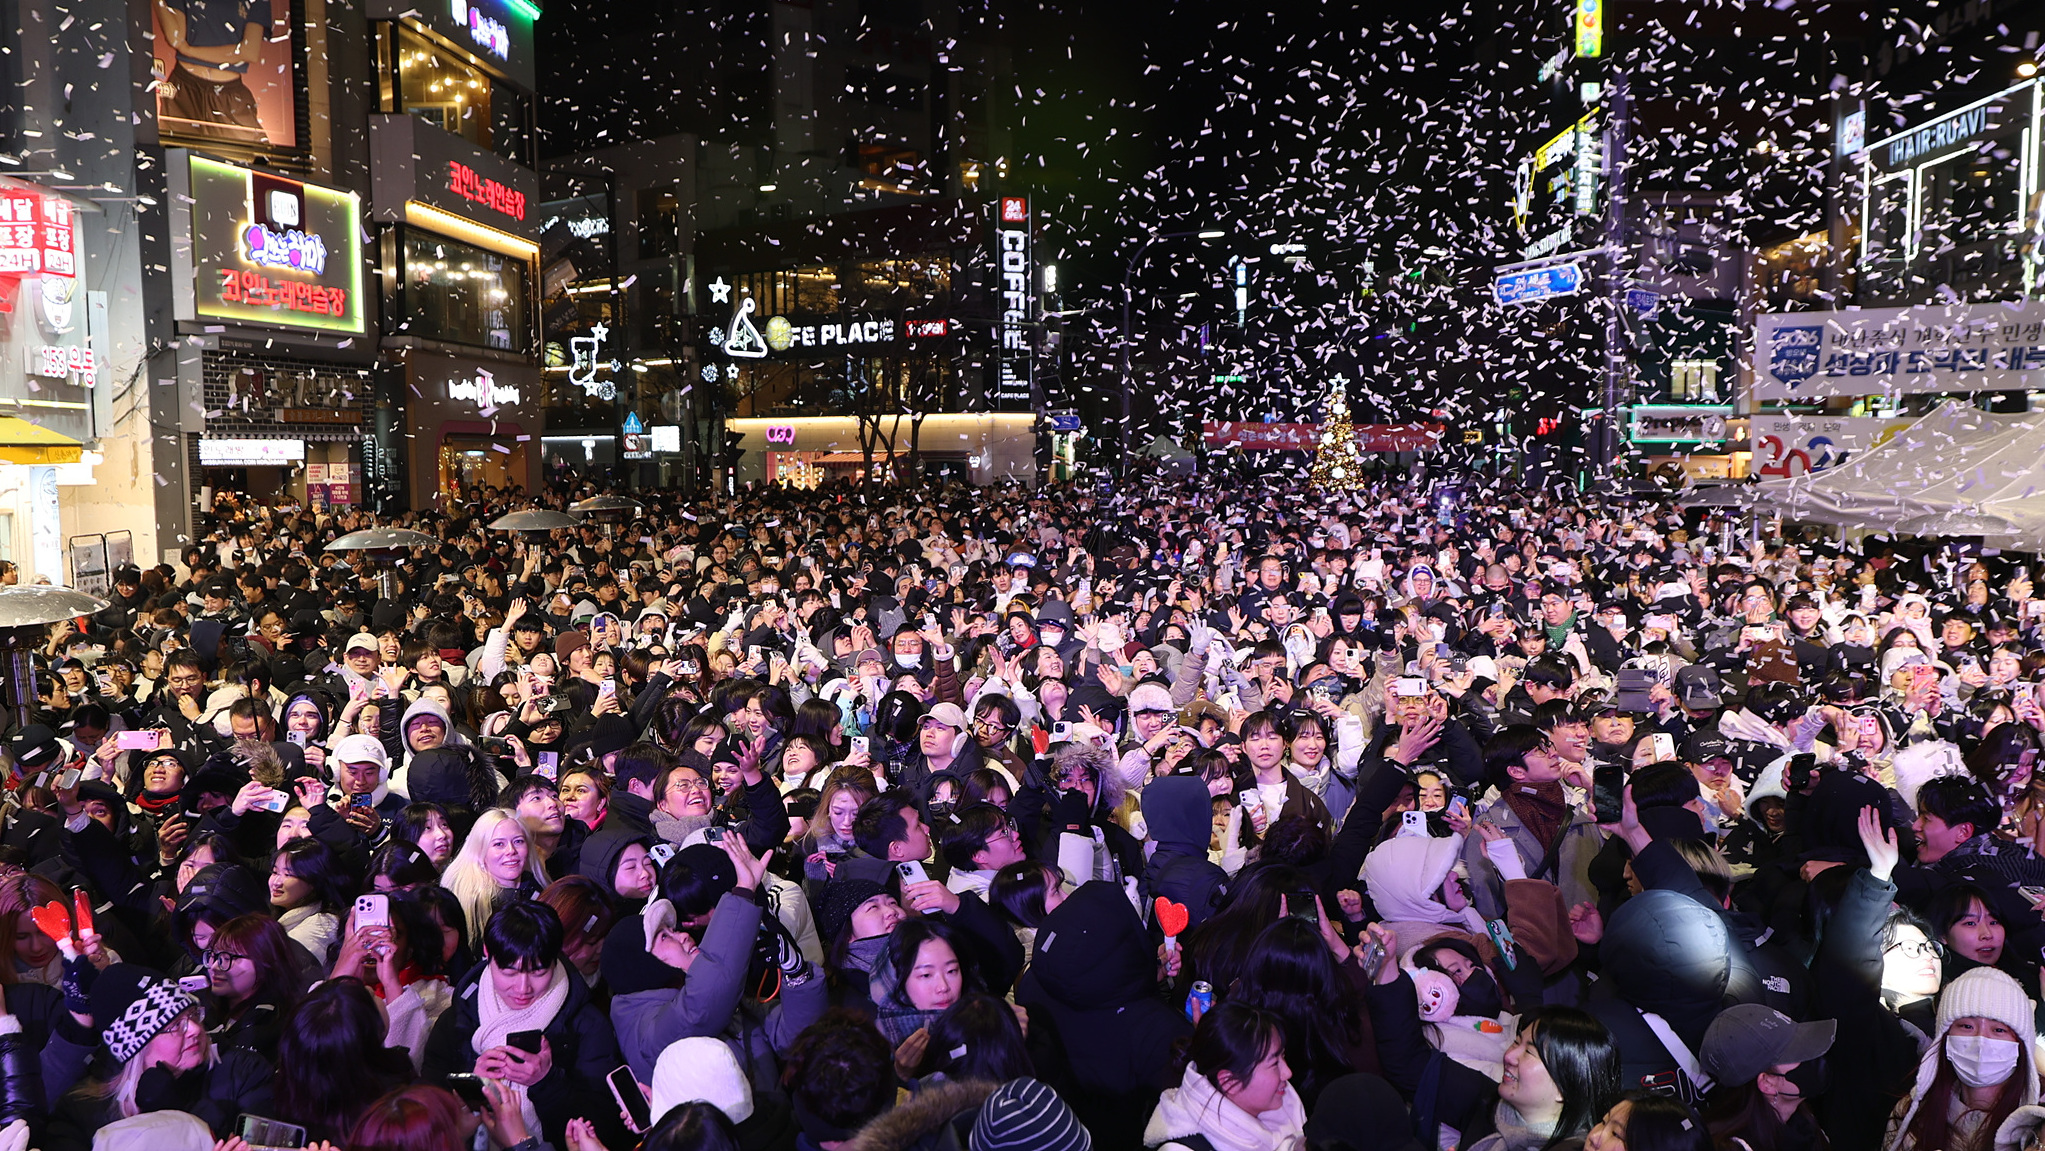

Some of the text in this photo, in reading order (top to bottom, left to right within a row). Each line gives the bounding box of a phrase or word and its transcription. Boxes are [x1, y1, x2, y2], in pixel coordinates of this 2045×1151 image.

[449, 160, 526, 221] 코인노래연습장
[1006, 200, 1021, 211] 24
[46, 229, 70, 251] 포장
[50, 254, 70, 269] 24H
[222, 269, 346, 317] 코인노래연습장
[1003, 230, 1025, 349] COFFEE
[820, 320, 895, 345] PLACE
[42, 345, 98, 388] 153 우동
[1774, 422, 1791, 432] 민생
[1823, 422, 1842, 433] 도약
[1758, 434, 1850, 479] 202
